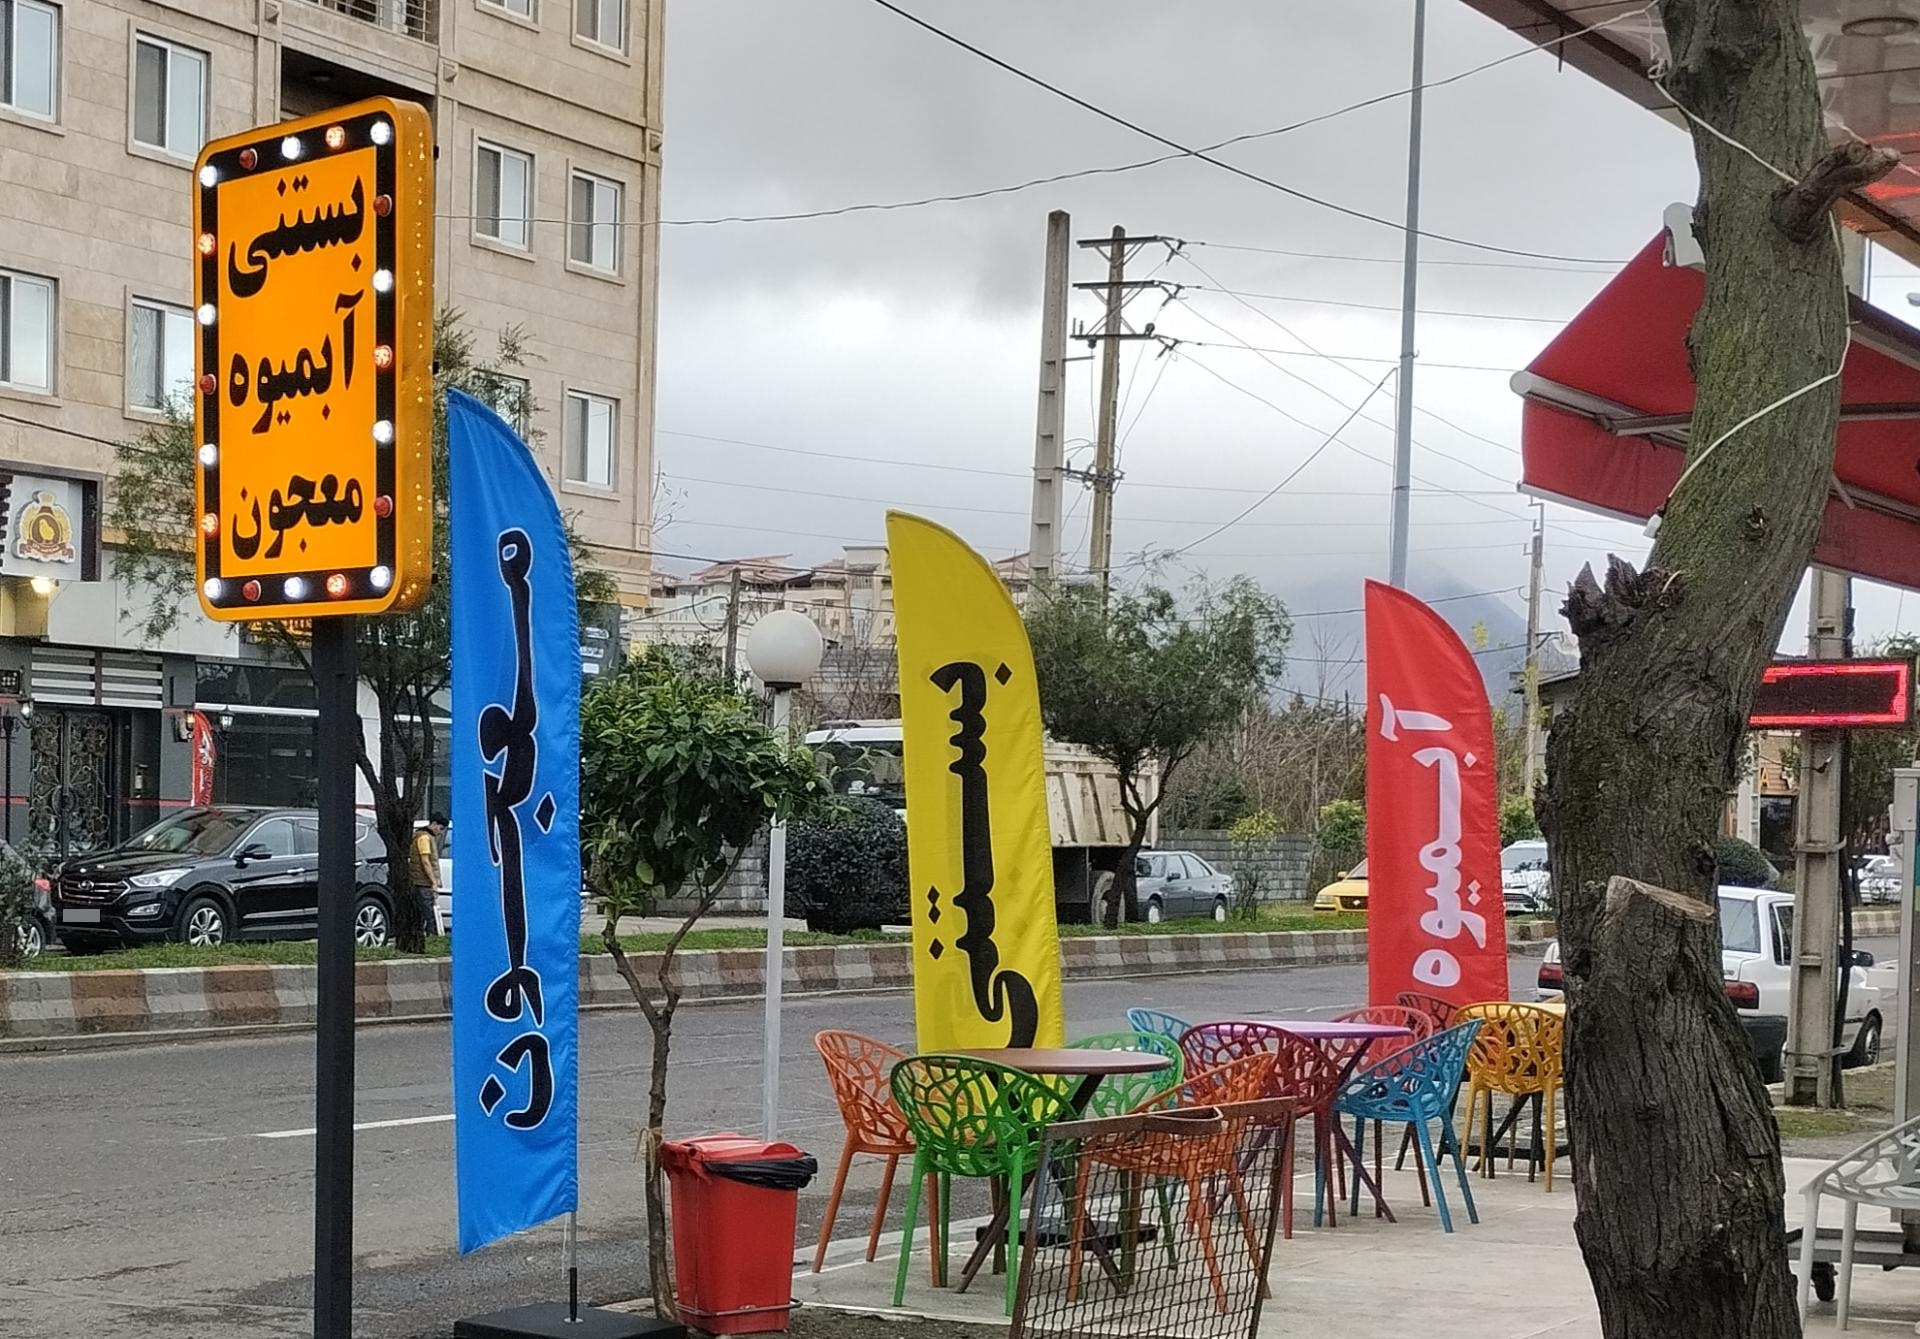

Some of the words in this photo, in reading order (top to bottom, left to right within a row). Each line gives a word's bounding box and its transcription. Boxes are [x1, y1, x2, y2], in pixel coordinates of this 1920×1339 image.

[228, 175, 364, 298] بستنی
[229, 290, 364, 434] آبمیوه
[231, 474, 364, 559] معجون
[479, 527, 556, 1129] معجون
[926, 660, 1041, 1050] بستنی
[1379, 693, 1486, 987] آبمیوه
